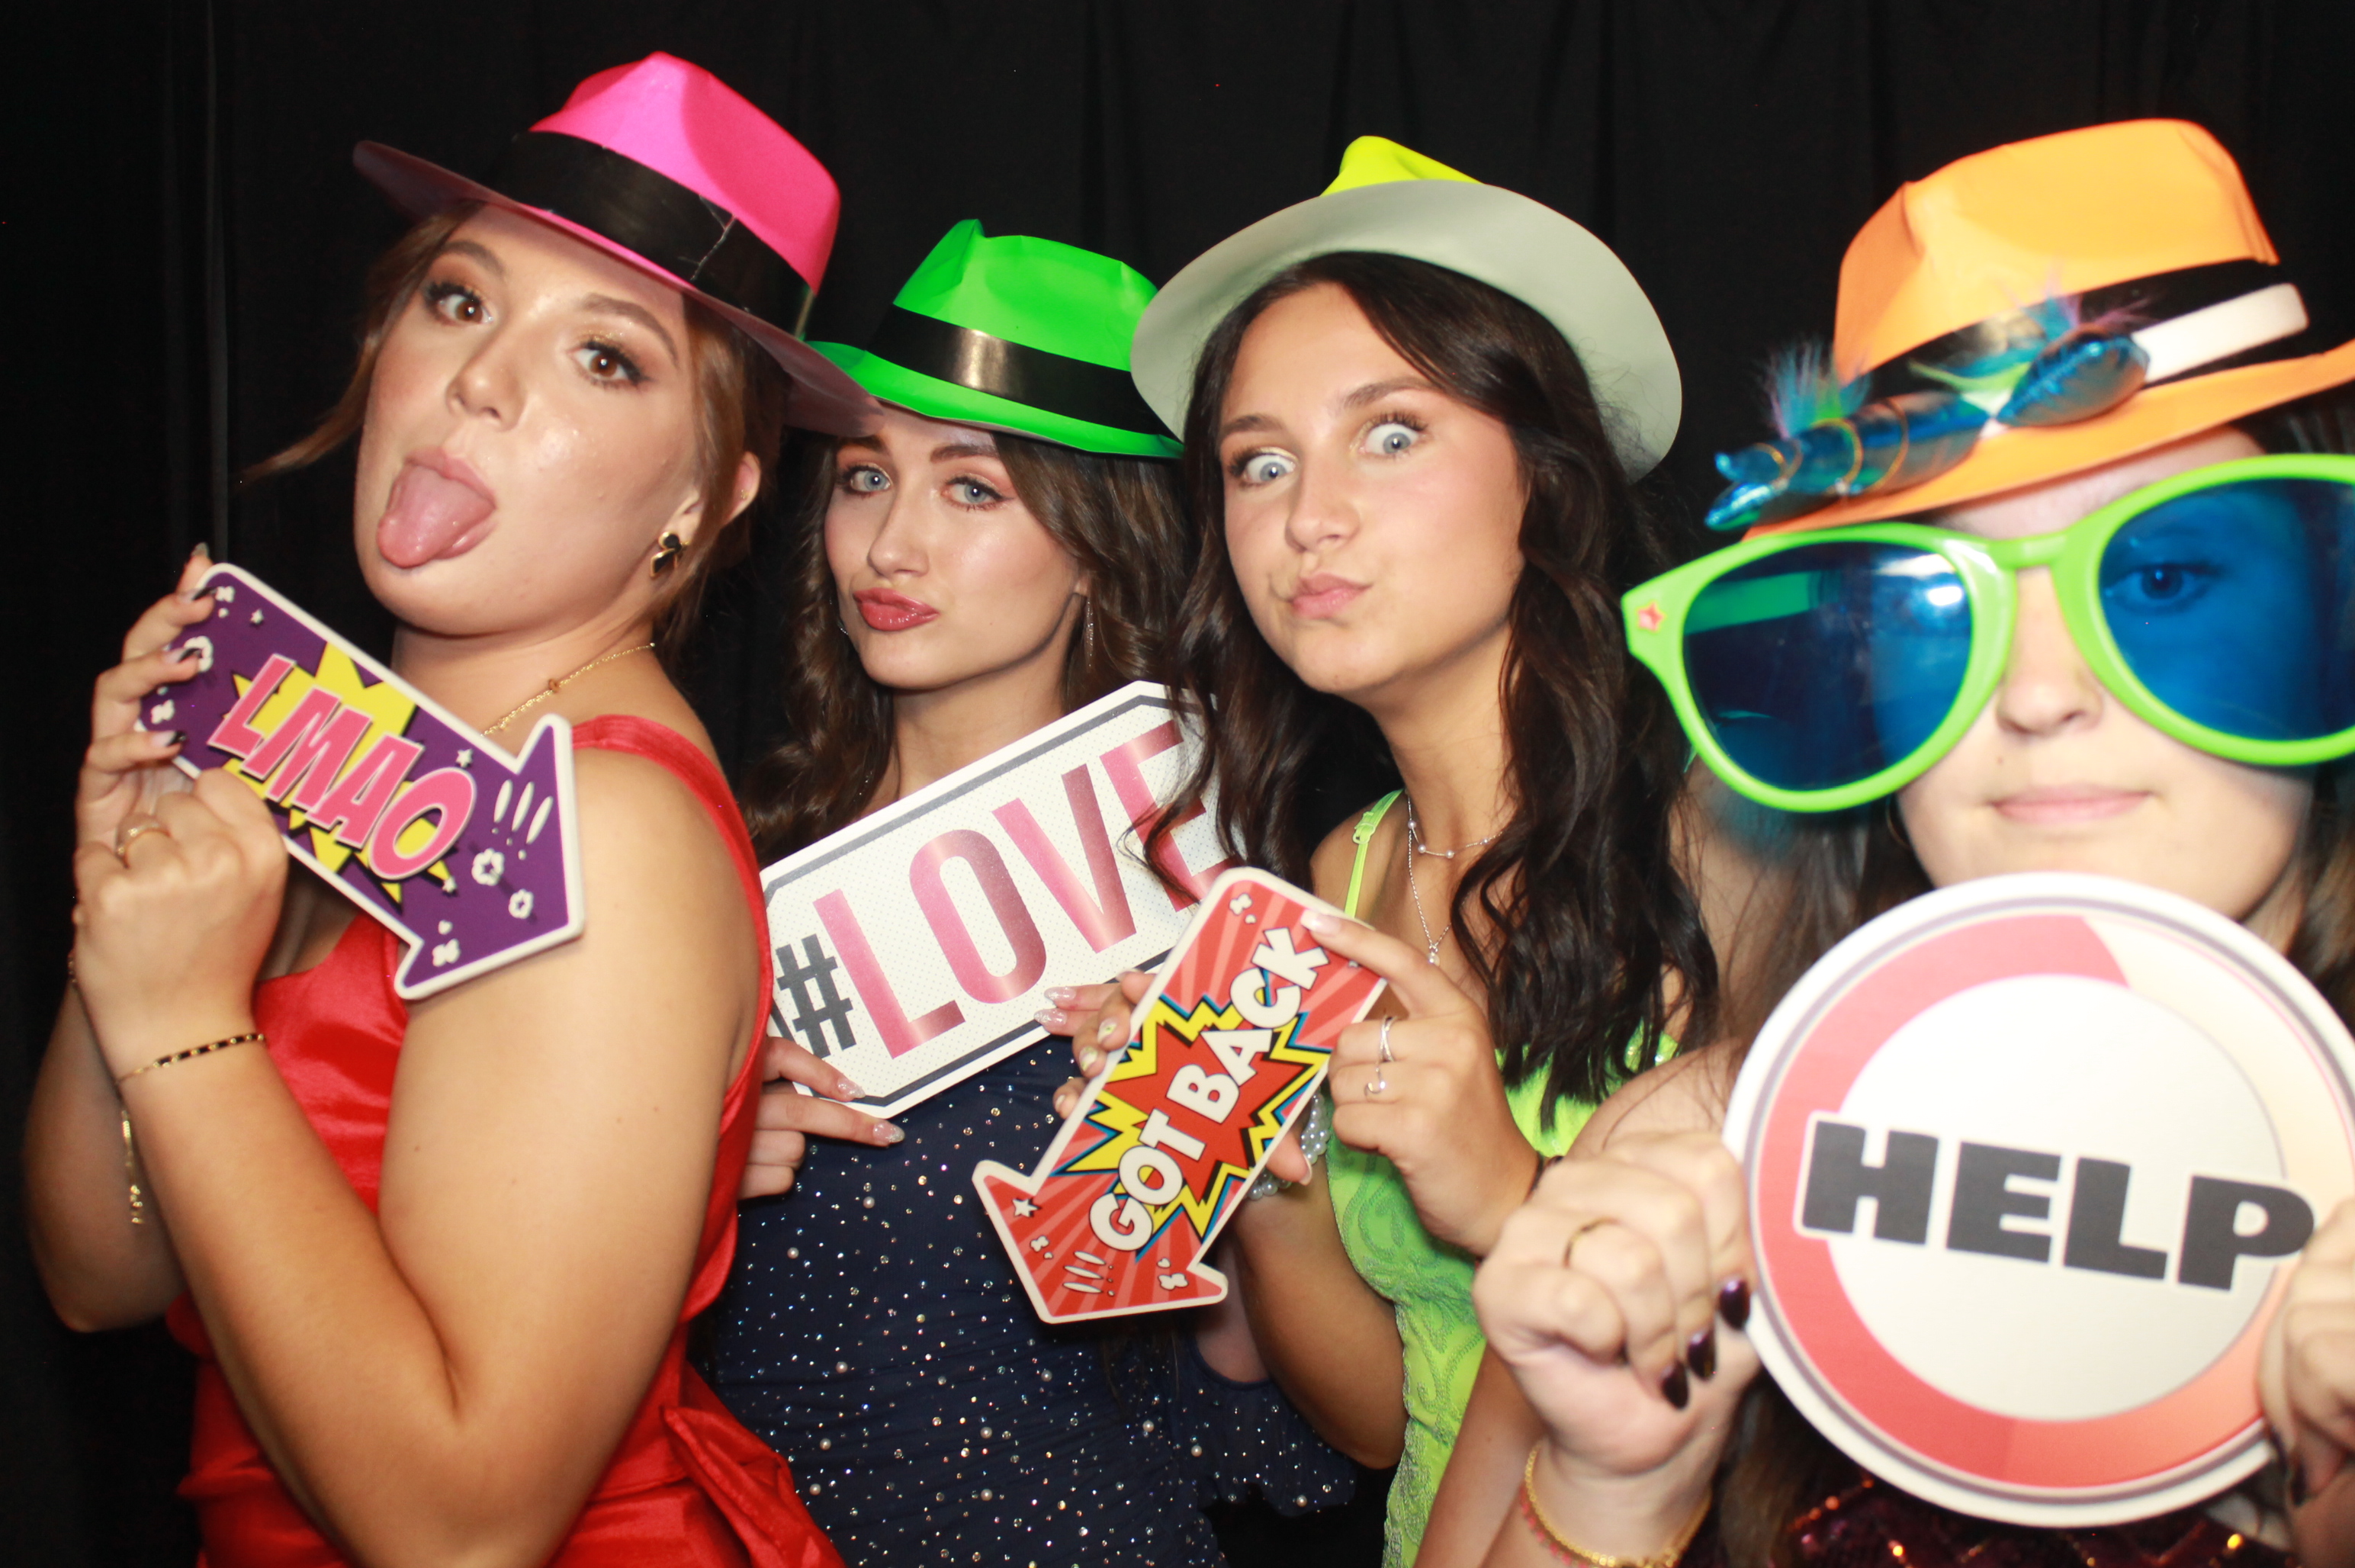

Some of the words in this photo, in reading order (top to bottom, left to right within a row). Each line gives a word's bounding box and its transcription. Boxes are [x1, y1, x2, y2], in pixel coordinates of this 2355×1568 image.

[205, 653, 477, 882] LMAO
[775, 718, 1239, 1060] #LOVE
[1089, 1107, 1206, 1251] GOT
[1166, 927, 1330, 1124] BACK
[1801, 1119, 2315, 1291] HELP
